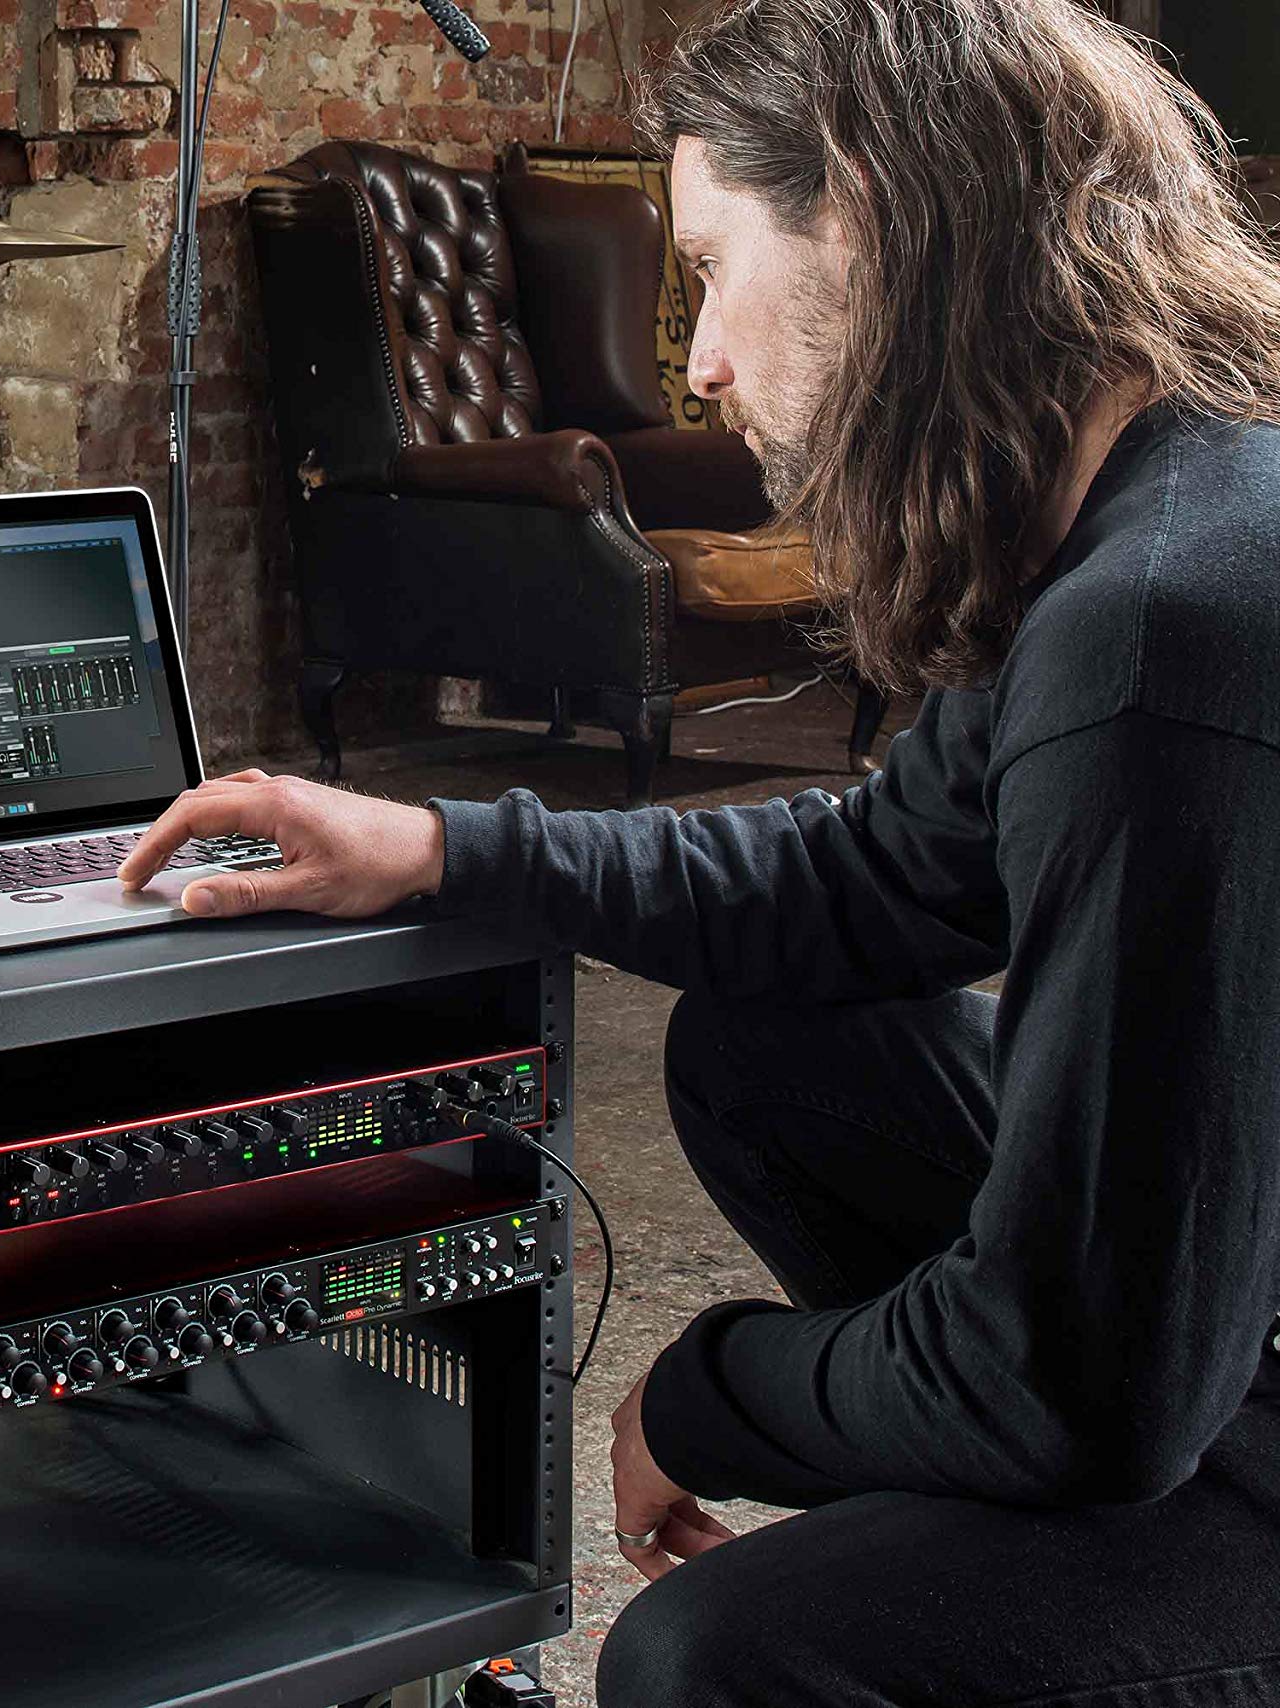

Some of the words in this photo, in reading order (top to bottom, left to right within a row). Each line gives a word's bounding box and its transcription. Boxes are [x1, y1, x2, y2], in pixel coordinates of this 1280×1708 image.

[514, 1271, 544, 1285] Focusrite
[320, 1312, 345, 1326] Scarlett
[376, 1301, 402, 1312] Dynamic
